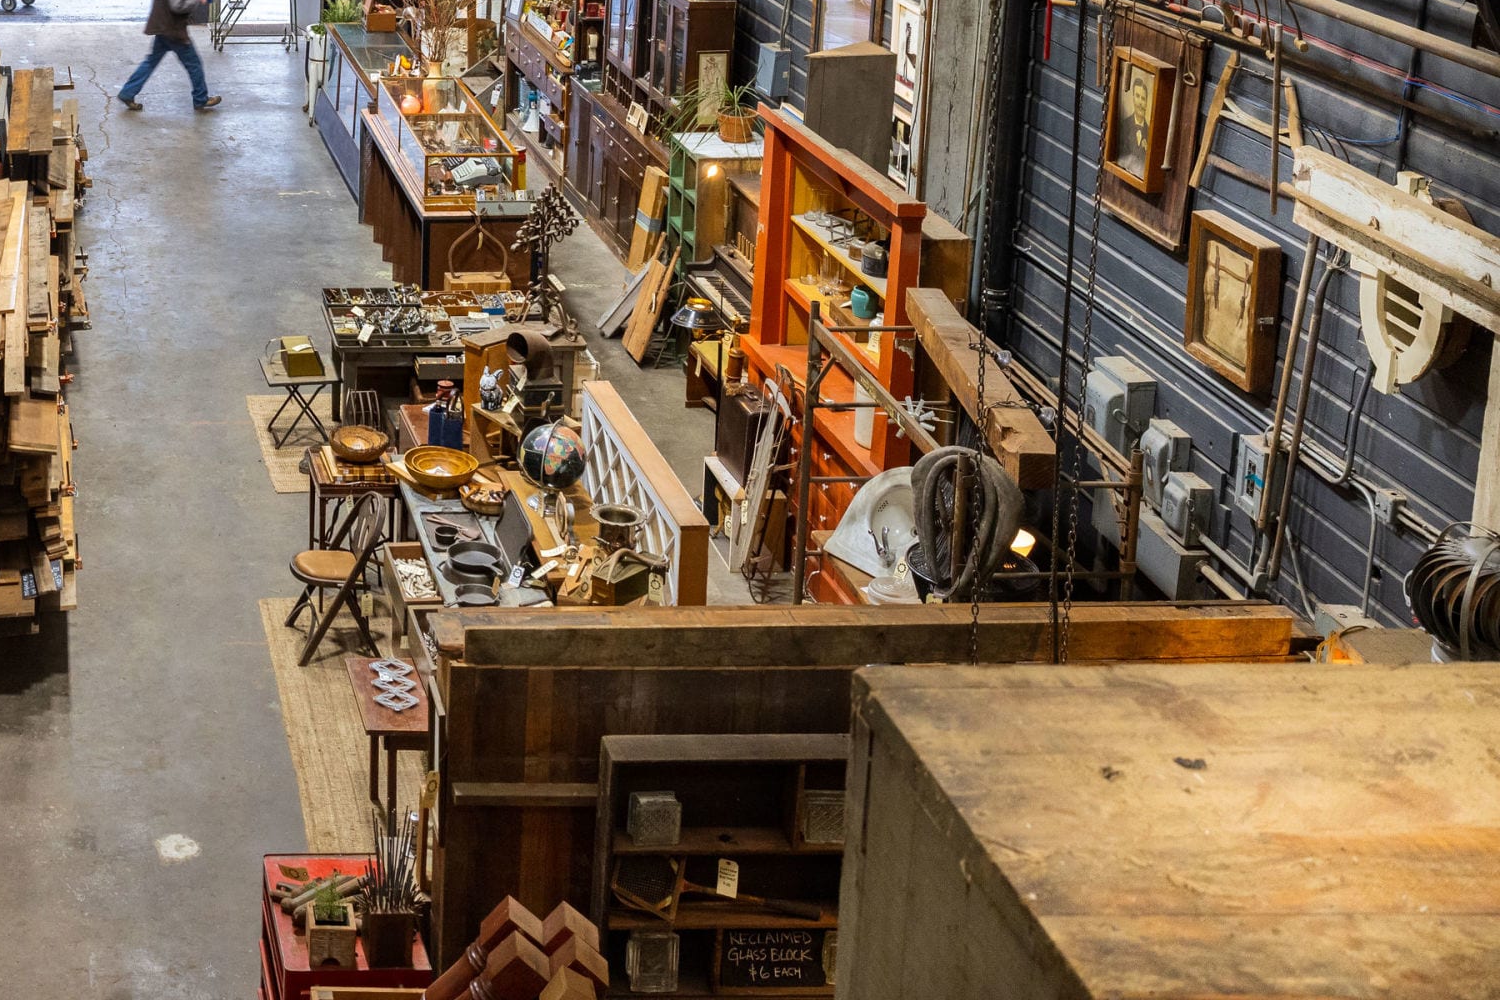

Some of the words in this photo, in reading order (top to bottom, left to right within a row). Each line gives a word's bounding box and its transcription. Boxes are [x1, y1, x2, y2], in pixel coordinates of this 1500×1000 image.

[729, 931, 812, 945] RECLAIMED
[727, 947, 767, 966] GLASS
[770, 948, 814, 962] BLOCK
[748, 963, 770, 982] $6
[774, 966, 801, 979] EACH
